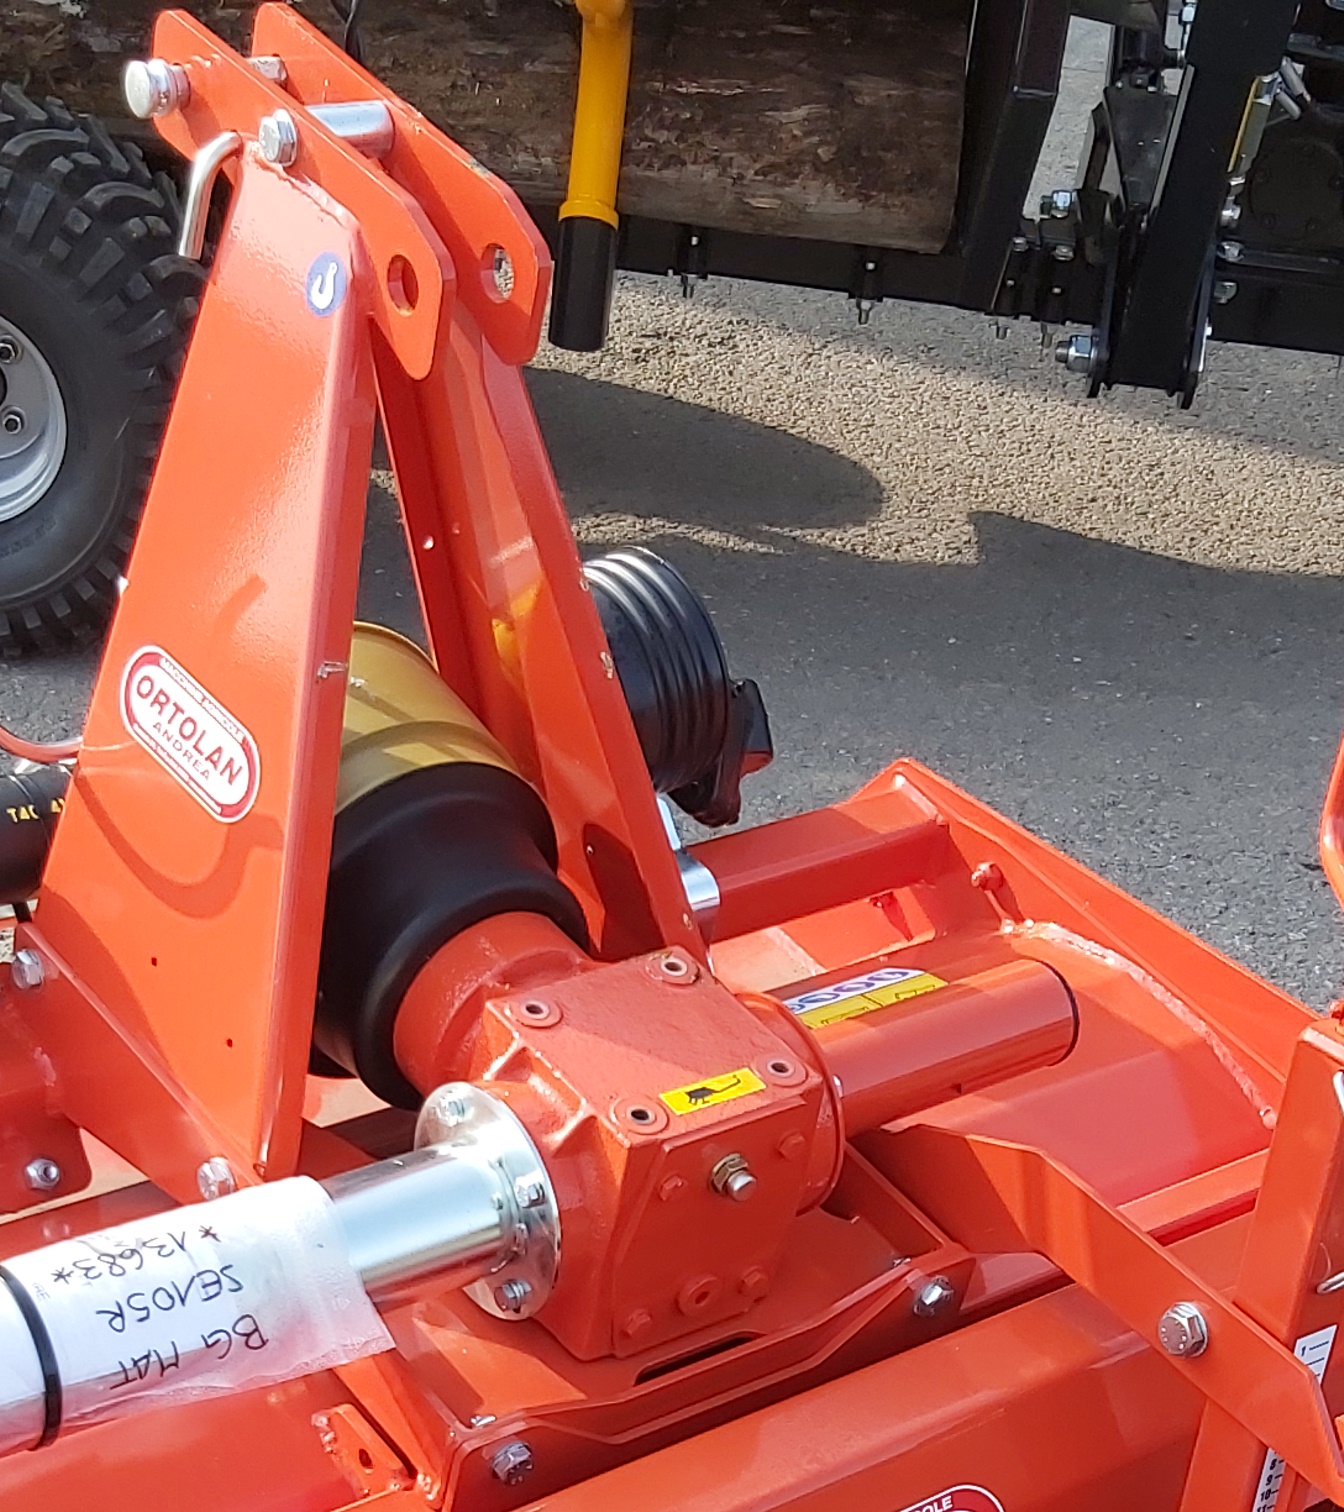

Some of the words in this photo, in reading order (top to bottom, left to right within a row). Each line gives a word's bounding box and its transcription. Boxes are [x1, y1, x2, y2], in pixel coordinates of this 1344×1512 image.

[137, 675, 243, 786] ORTOLAN
[153, 722, 210, 780] ANDREA
[96, 1264, 243, 1333] SE105R
[201, 1314, 269, 1359] BG
[110, 1341, 179, 1390] MAT
[1260, 1488, 1272, 1502] 10
[1266, 1474, 1273, 1486] 9
